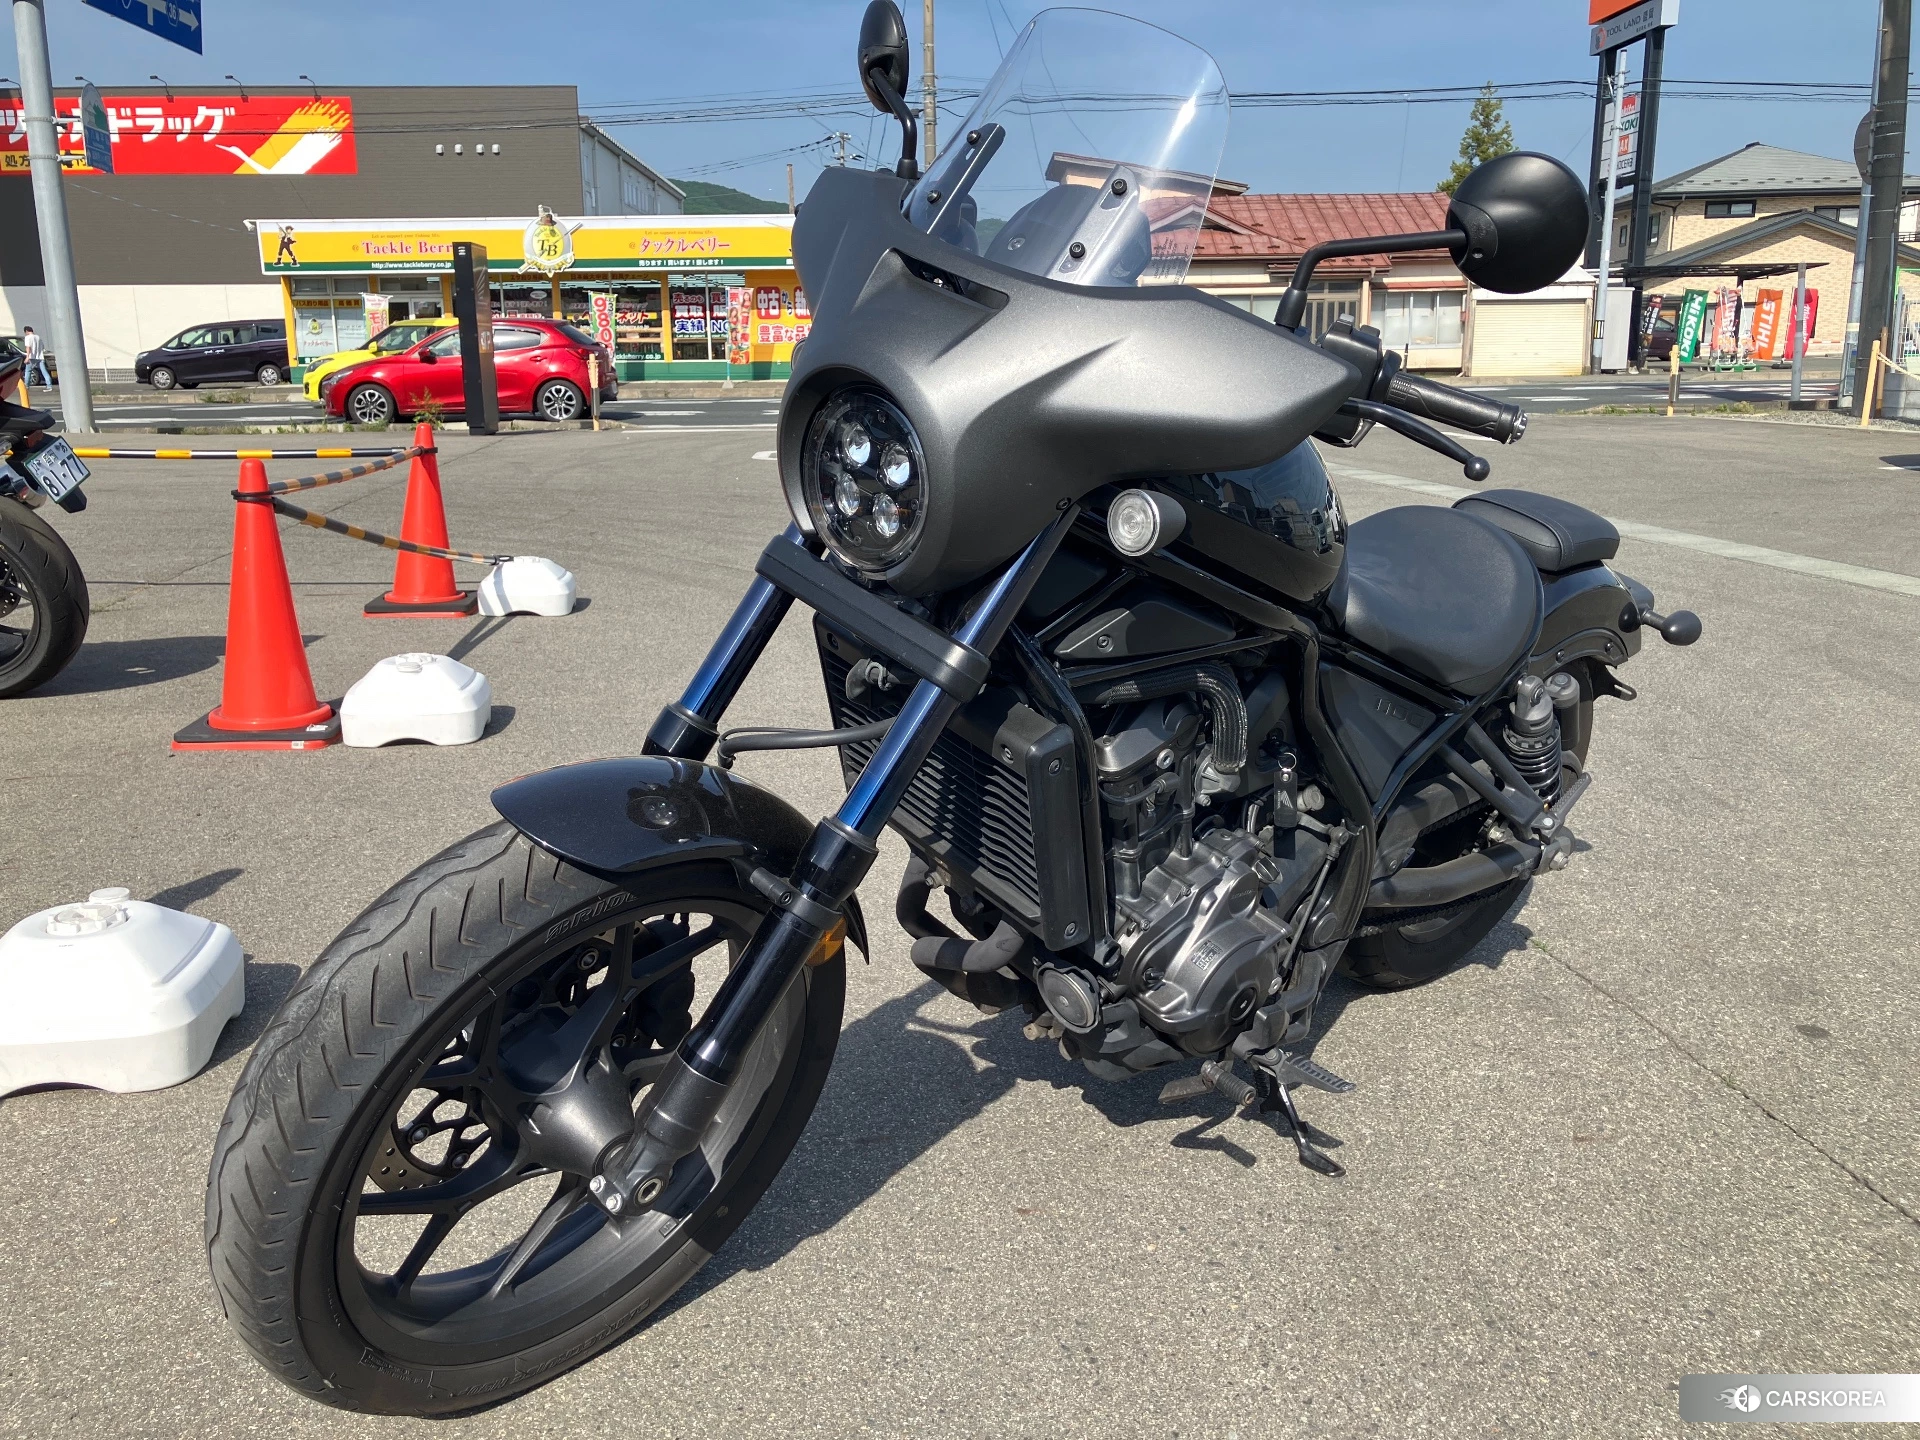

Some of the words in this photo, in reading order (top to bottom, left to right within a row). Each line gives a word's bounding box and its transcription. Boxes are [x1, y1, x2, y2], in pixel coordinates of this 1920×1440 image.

[1606, 25, 1622, 38] TOOL
[1623, 15, 1641, 30] LAND
[362, 240, 412, 255] Tackle
[418, 240, 453, 255] Berr
[639, 237, 730, 255] タックルベリー
[674, 305, 704, 317] 買取
[757, 289, 780, 317] 中古
[675, 320, 705, 333] 実績
[1756, 298, 1776, 349] STIHL
[759, 324, 811, 342] 豊富な品
